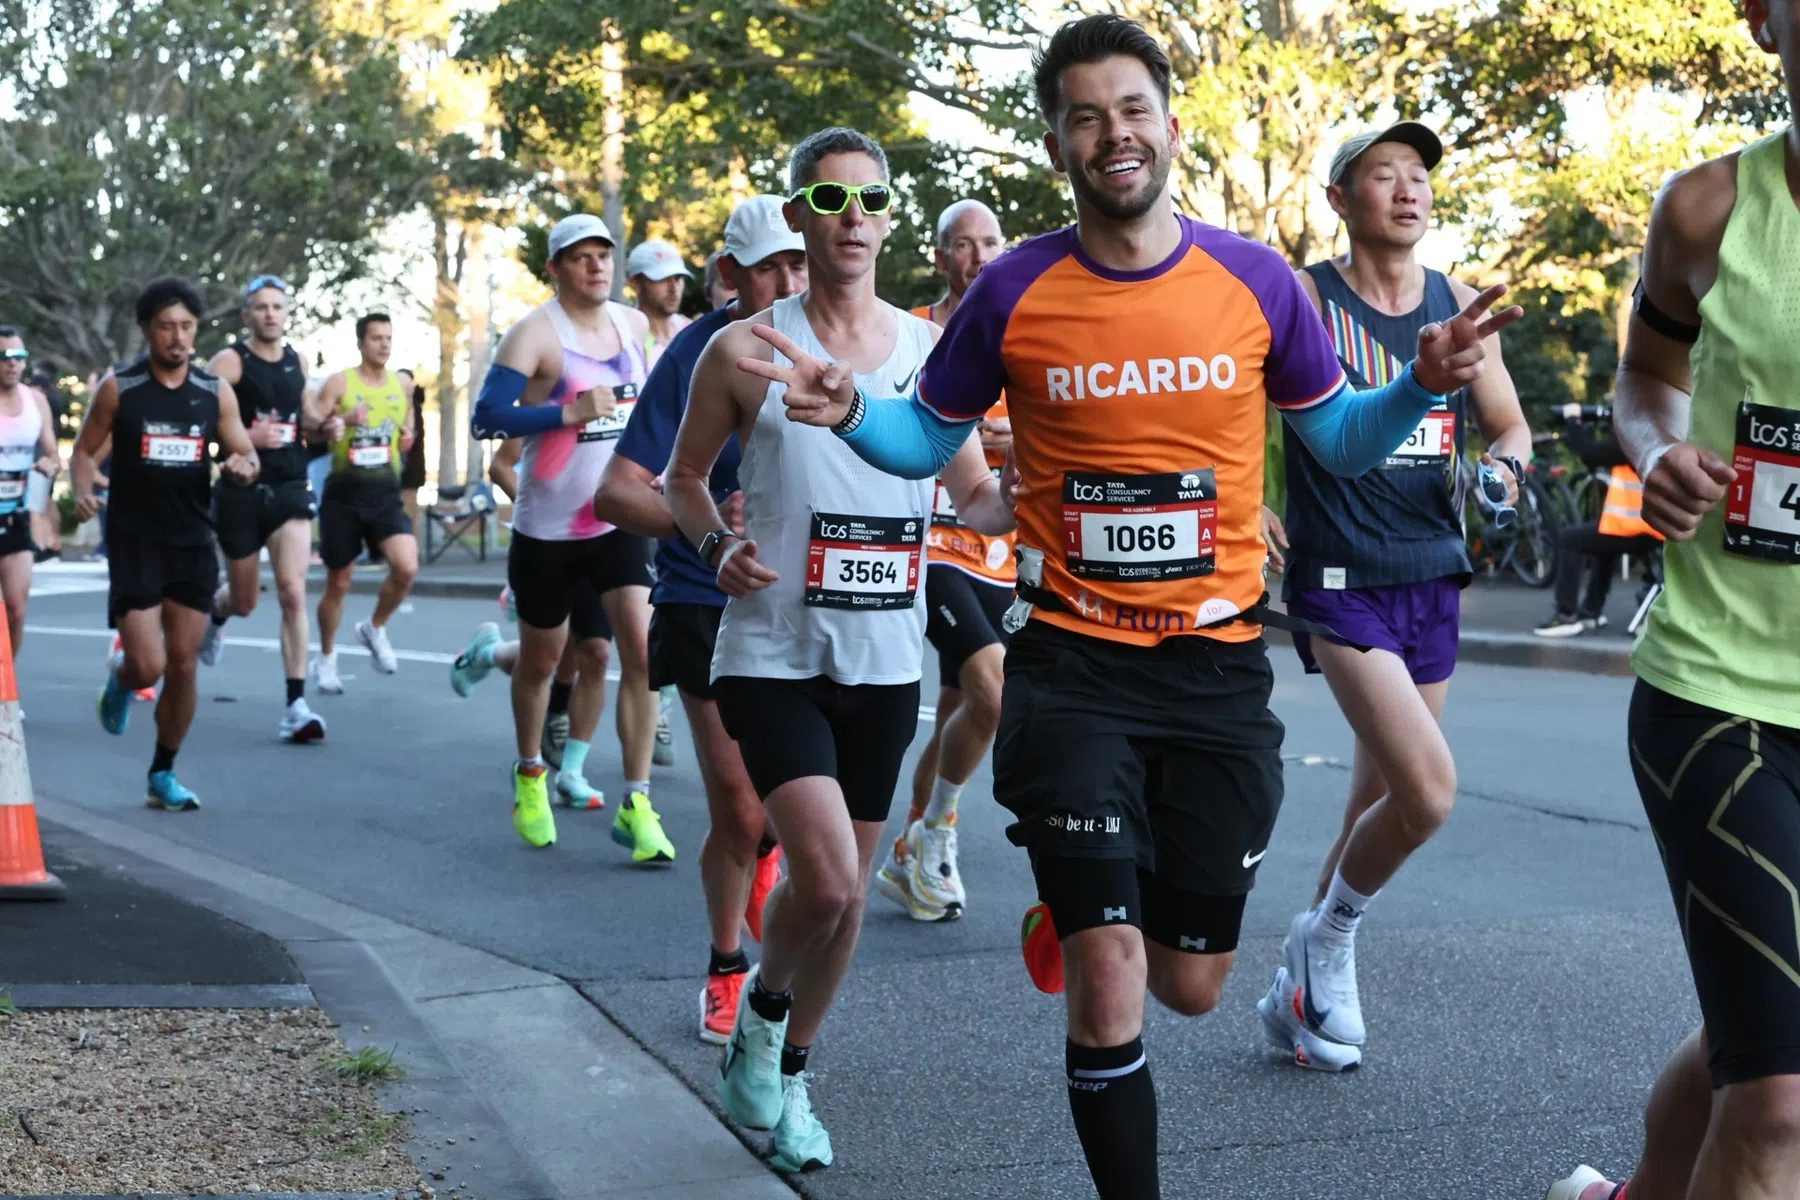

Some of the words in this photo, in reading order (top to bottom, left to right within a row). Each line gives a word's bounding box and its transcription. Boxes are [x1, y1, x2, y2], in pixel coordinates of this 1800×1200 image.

[1046, 354, 1236, 401] RICARDO
[1750, 416, 1788, 448] tcs
[157, 443, 189, 456] 2557
[1073, 480, 1103, 501] tcs
[1106, 488, 1151, 496] CONSULTANCY
[1178, 490, 1204, 500] TATA
[1736, 485, 1743, 501] 1
[821, 520, 847, 539] tcs
[849, 528, 885, 536] CONSULTANCY
[1202, 528, 1212, 541] A
[1069, 531, 1075, 544] 1
[1103, 524, 1176, 552] 1066
[813, 564, 818, 574] 1
[839, 559, 897, 584] 3564
[909, 568, 916, 578] B
[1118, 566, 1135, 577] tcs
[852, 595, 865, 605] tcs
[1114, 604, 1184, 631] Run
[1206, 606, 1222, 616] for
[1066, 813, 1081, 831] be
